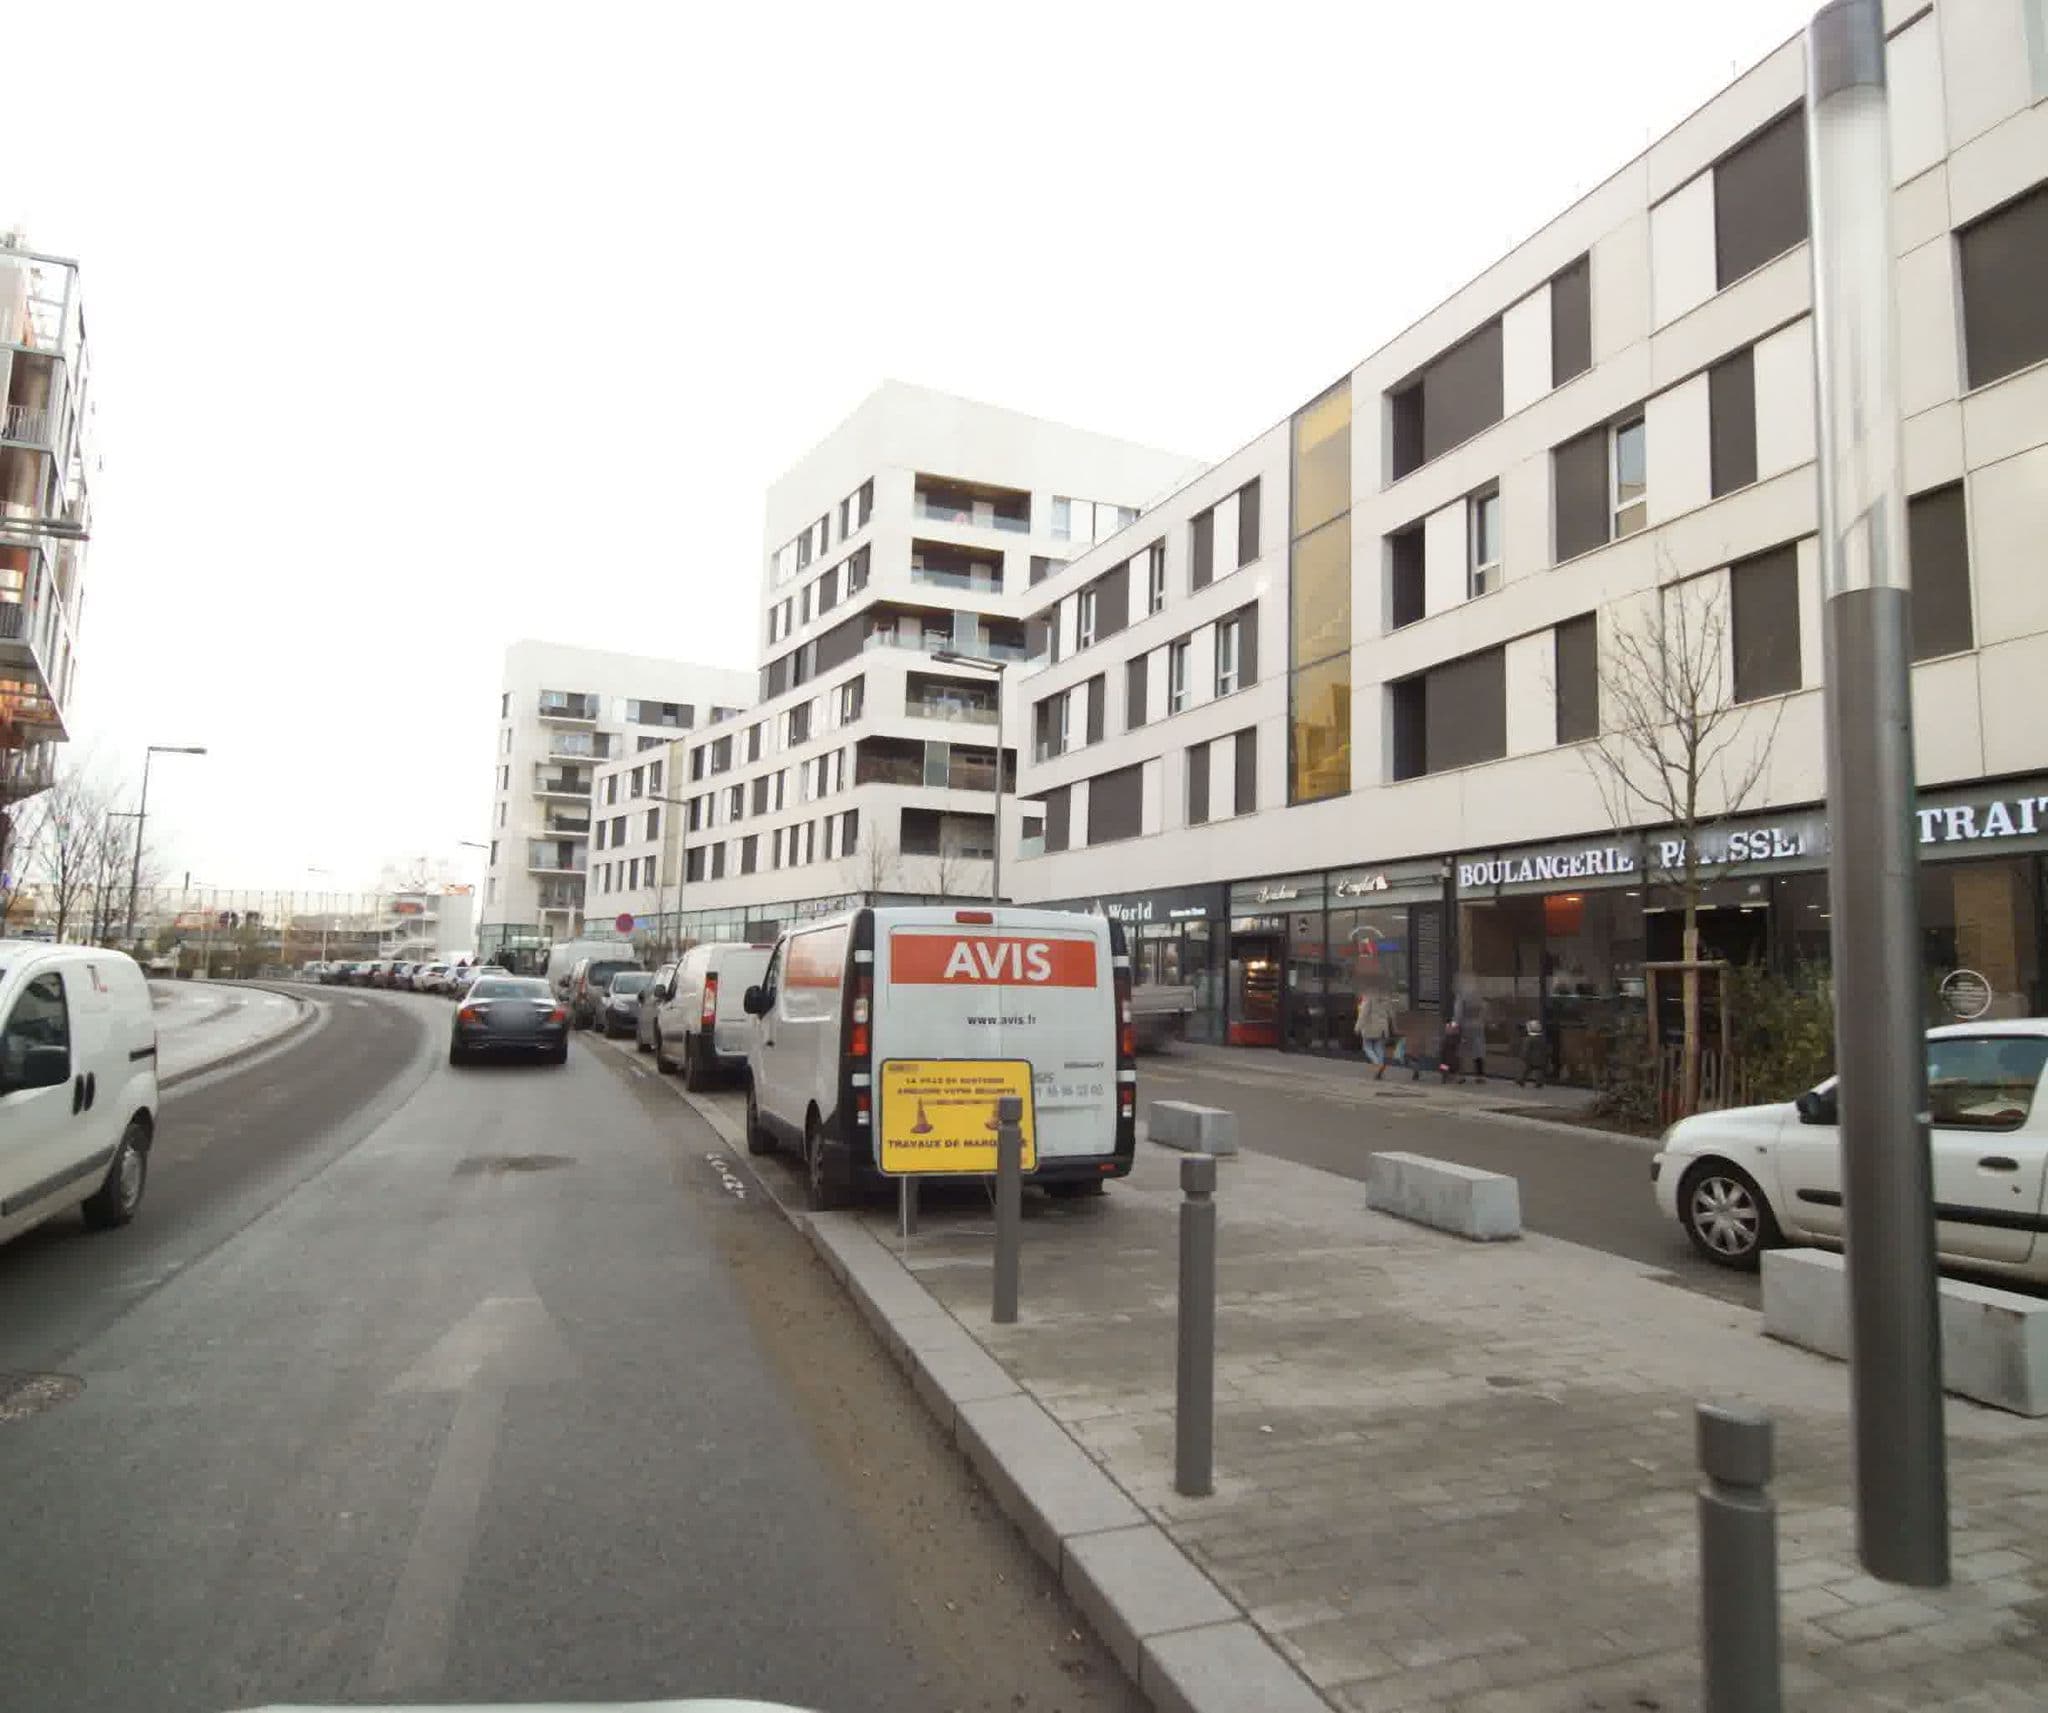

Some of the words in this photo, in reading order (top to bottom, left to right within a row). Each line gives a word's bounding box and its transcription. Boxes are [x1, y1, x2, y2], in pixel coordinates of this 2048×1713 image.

[1459, 848, 1633, 888] BOULANGERIE
[1108, 902, 1152, 921] World
[943, 941, 1052, 981] AVIS
[967, 1014, 1037, 1025] www.avis.fr
